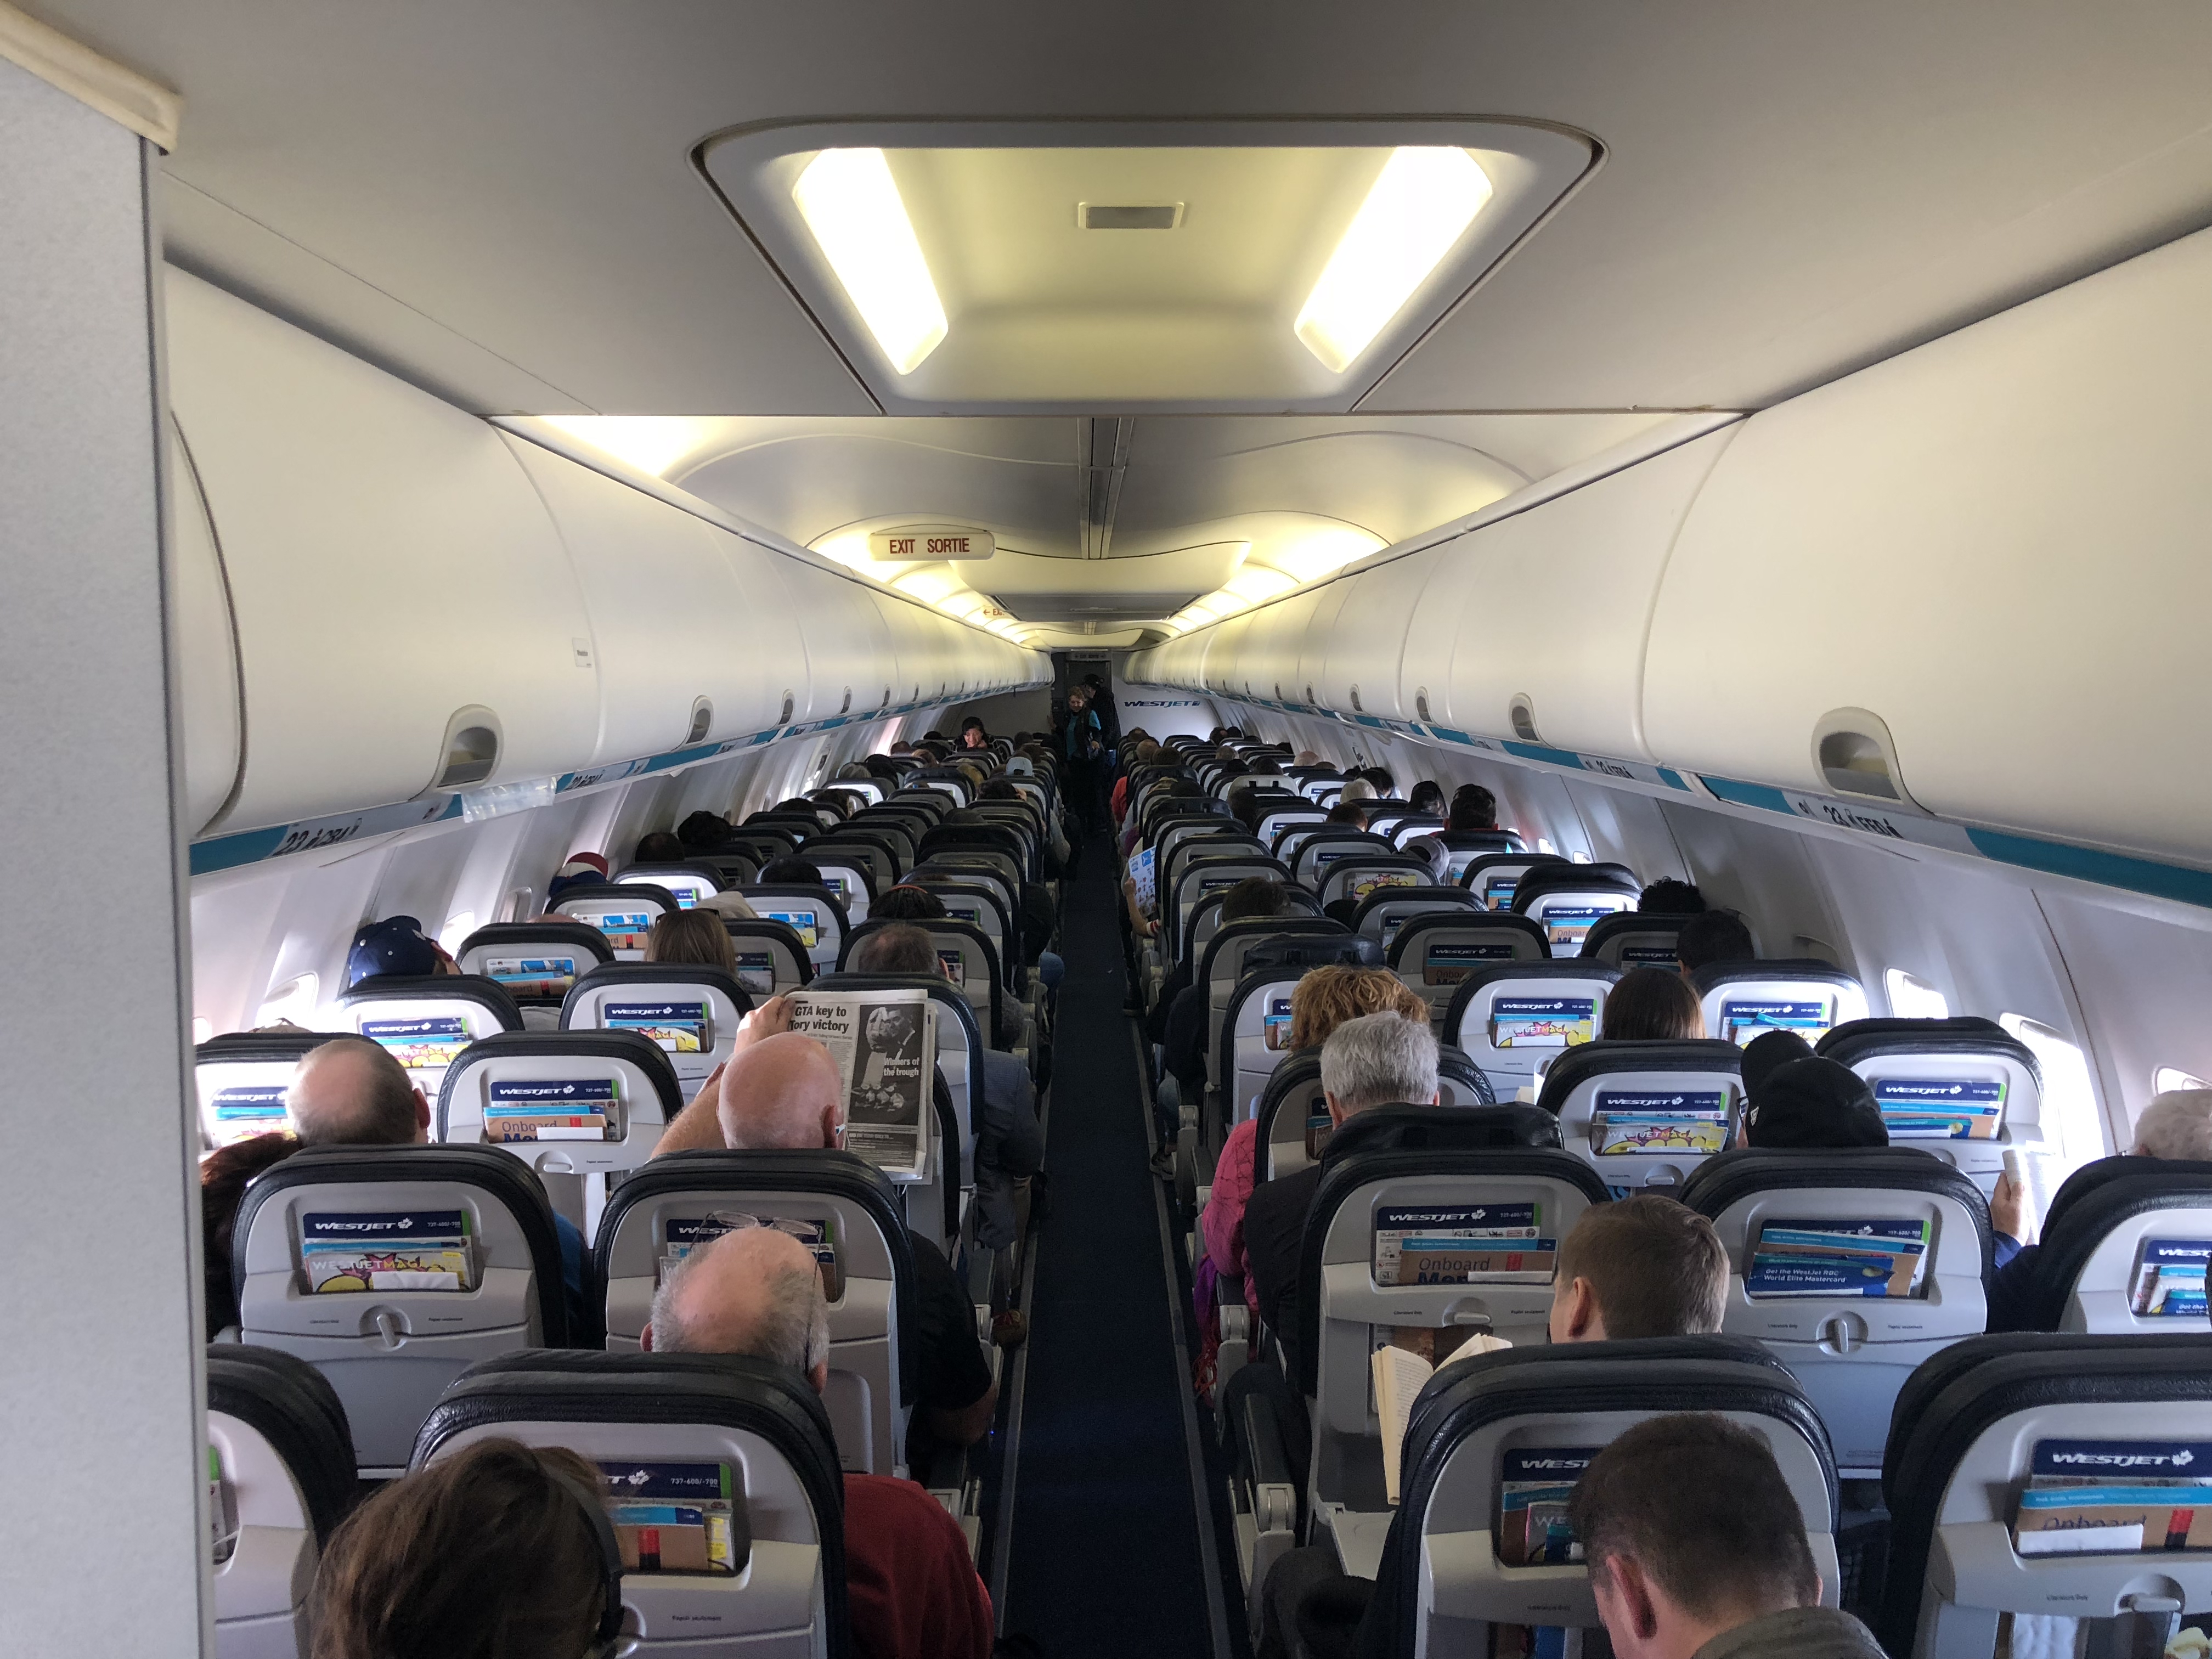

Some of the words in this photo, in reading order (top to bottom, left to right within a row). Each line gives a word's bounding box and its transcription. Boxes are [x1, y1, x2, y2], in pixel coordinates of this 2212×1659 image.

[889, 539, 915, 554] EXIT
[927, 538, 970, 553] SORTIE
[795, 1006, 813, 1017] GTA
[815, 1006, 834, 1019] key
[836, 1007, 847, 1017] to
[790, 1020, 810, 1032] Tory
[812, 1020, 849, 1034] victory
[884, 1057, 911, 1066] Winners
[912, 1057, 920, 1065] of
[883, 1068, 895, 1076] the
[896, 1067, 919, 1076] trough
[1389, 1213, 1470, 1222] WESTJET
[315, 1222, 396, 1232] WESTJET
[1418, 1257, 1491, 1272] Onboard
[2052, 1453, 2170, 1467] WESTJET
